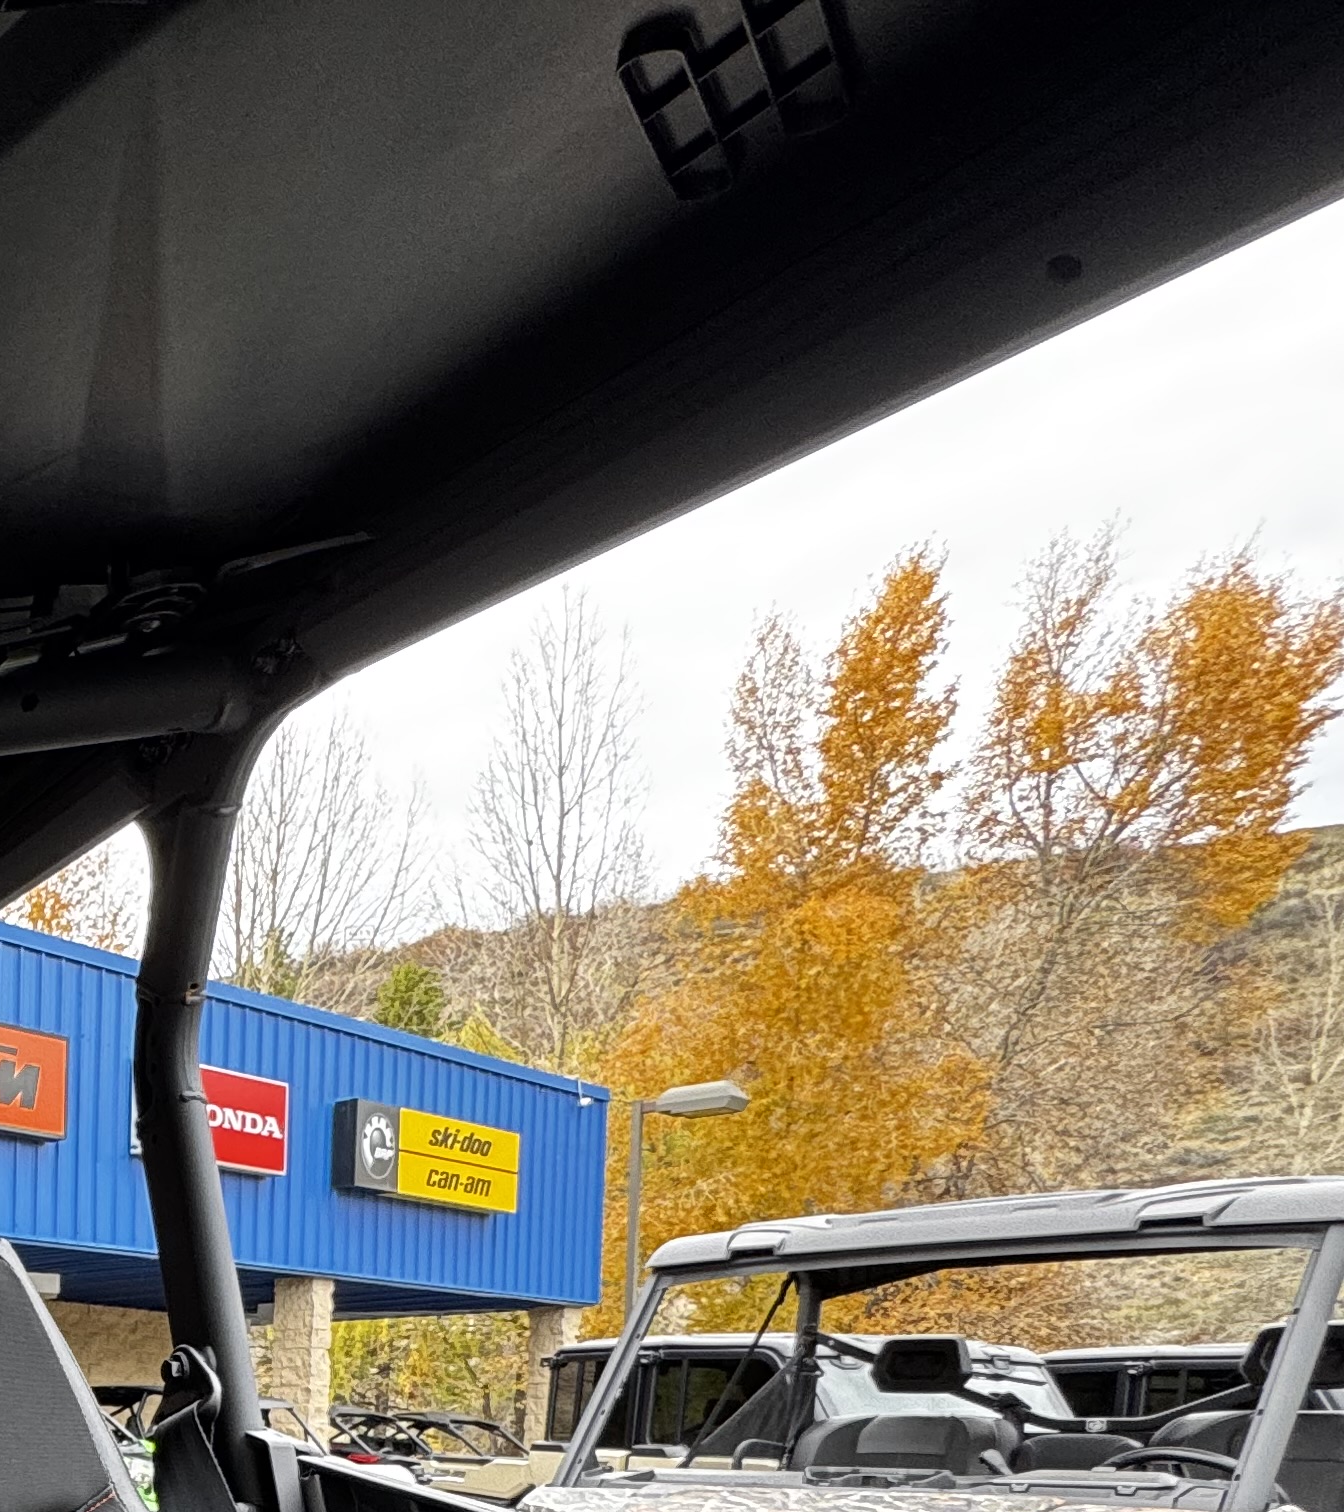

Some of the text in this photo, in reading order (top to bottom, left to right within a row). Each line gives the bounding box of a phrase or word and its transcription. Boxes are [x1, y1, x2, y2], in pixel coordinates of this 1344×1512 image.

[206, 1103, 283, 1140] ONDA
[429, 1127, 492, 1157] ski-doo
[426, 1169, 492, 1197] can-am
